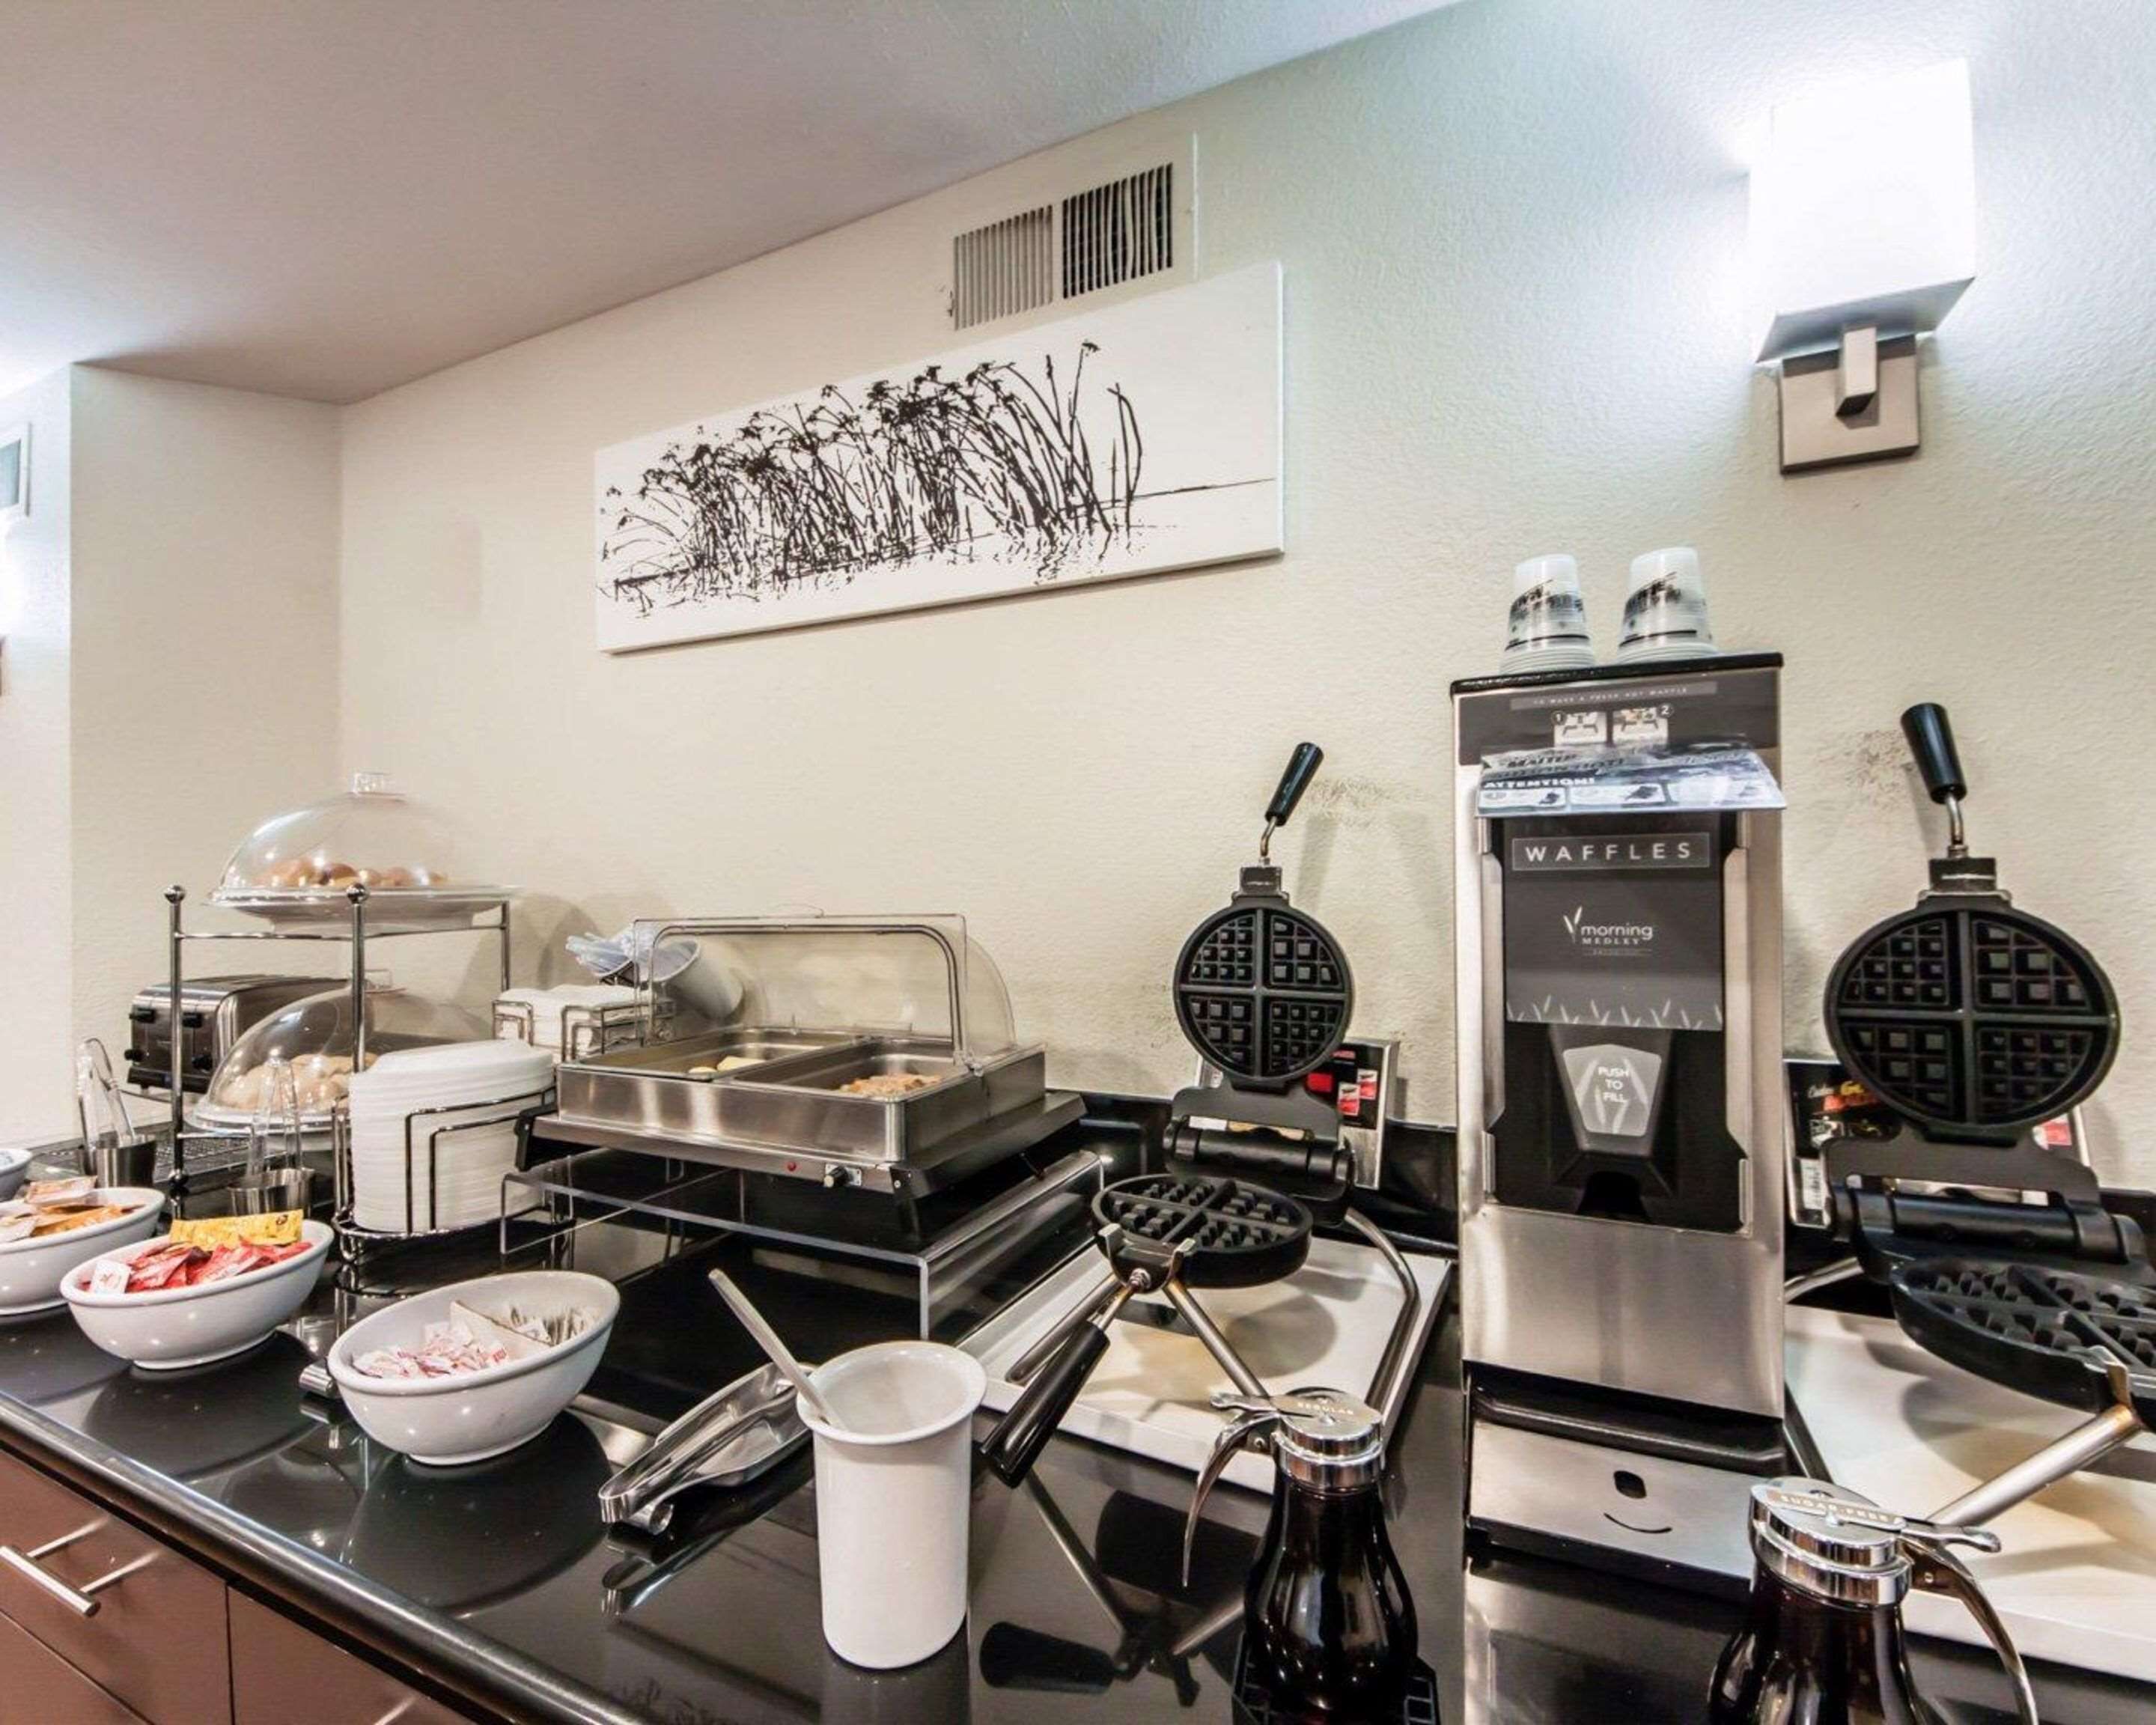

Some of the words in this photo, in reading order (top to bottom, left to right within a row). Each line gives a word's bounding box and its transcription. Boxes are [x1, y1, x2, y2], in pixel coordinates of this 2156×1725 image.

[1484, 777, 1595, 789] ATTENTION!
[1525, 842, 1691, 862] WAFFLES
[1581, 922, 1653, 941] morning
[1598, 1066, 1630, 1078] PUSH
[1604, 1078, 1624, 1090] TO
[1604, 1092, 1627, 1103] FILL
